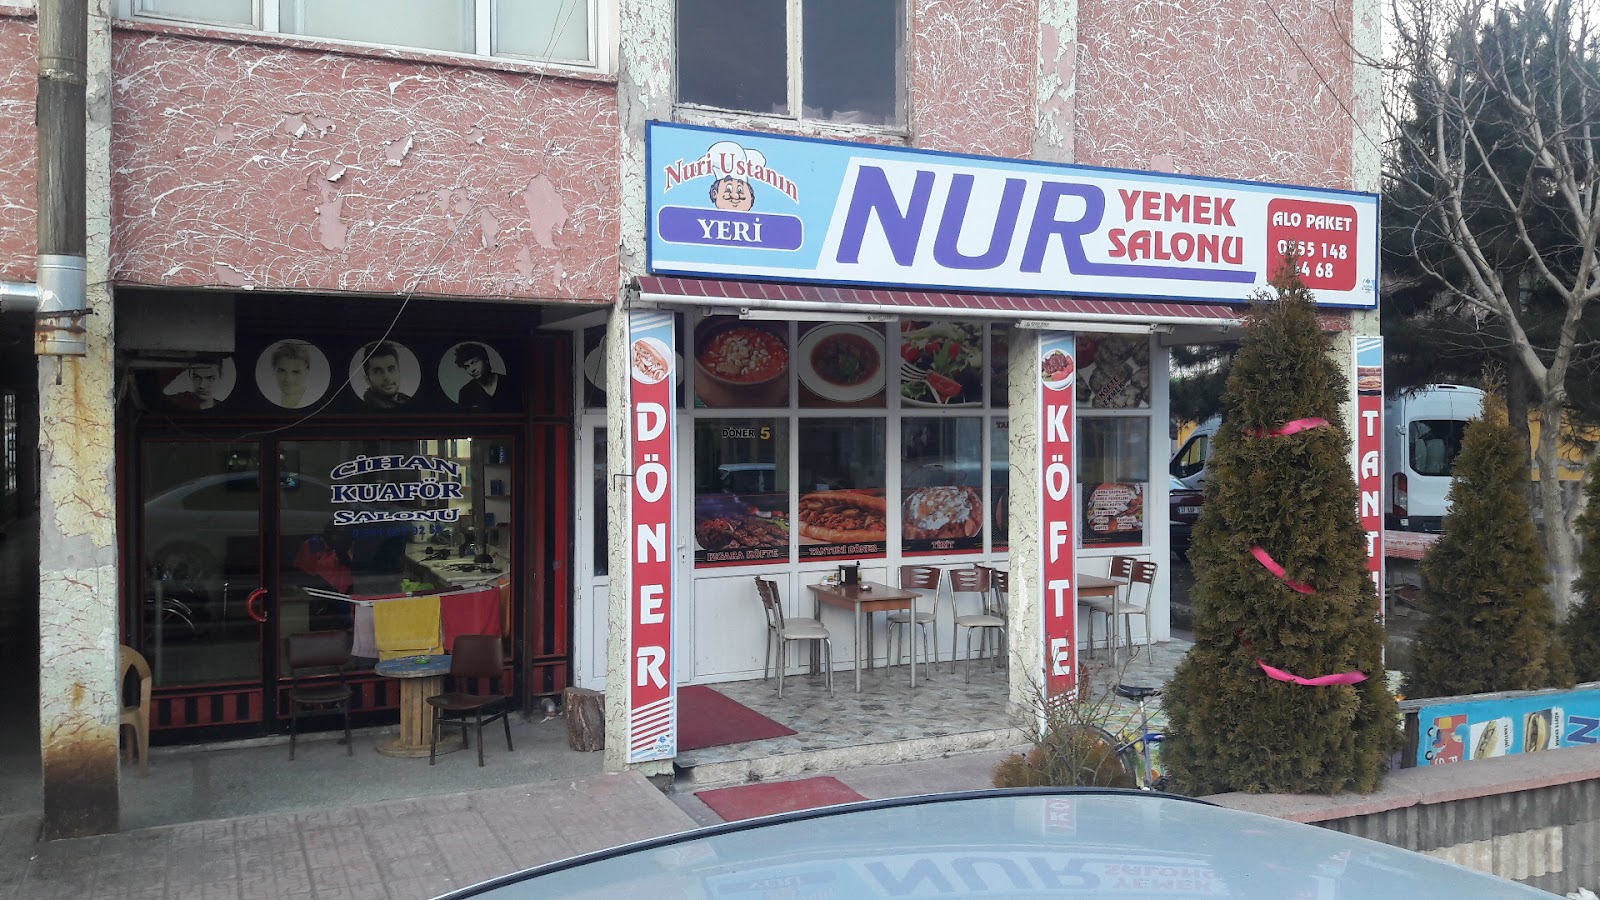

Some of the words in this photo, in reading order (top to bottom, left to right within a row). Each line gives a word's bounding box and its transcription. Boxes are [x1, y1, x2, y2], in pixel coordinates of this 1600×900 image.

[664, 153, 713, 192] Nuri
[718, 151, 800, 204] Ustanın
[836, 165, 1107, 276] NUR
[1117, 188, 1236, 228] YEMEK
[1273, 211, 1301, 227] ALO
[1305, 213, 1352, 231] PAKET
[697, 217, 763, 244] YERİ
[1108, 228, 1243, 265] SALONU
[1321, 243, 1348, 260] 148
[1316, 262, 1334, 279] 68
[722, 427, 755, 438] DÖNER
[760, 426, 771, 440] 5
[331, 455, 460, 480] CİHAN
[331, 477, 464, 504] KUAFÖR
[334, 508, 461, 526] SALONU
[636, 401, 668, 689] DÖNER
[808, 544, 847, 556] TANTUNİ
[848, 543, 879, 554] DÖNER
[1045, 404, 1070, 677] KÖFTE
[707, 551, 745, 562] IZGARA
[746, 548, 779, 560] KÖFTE
